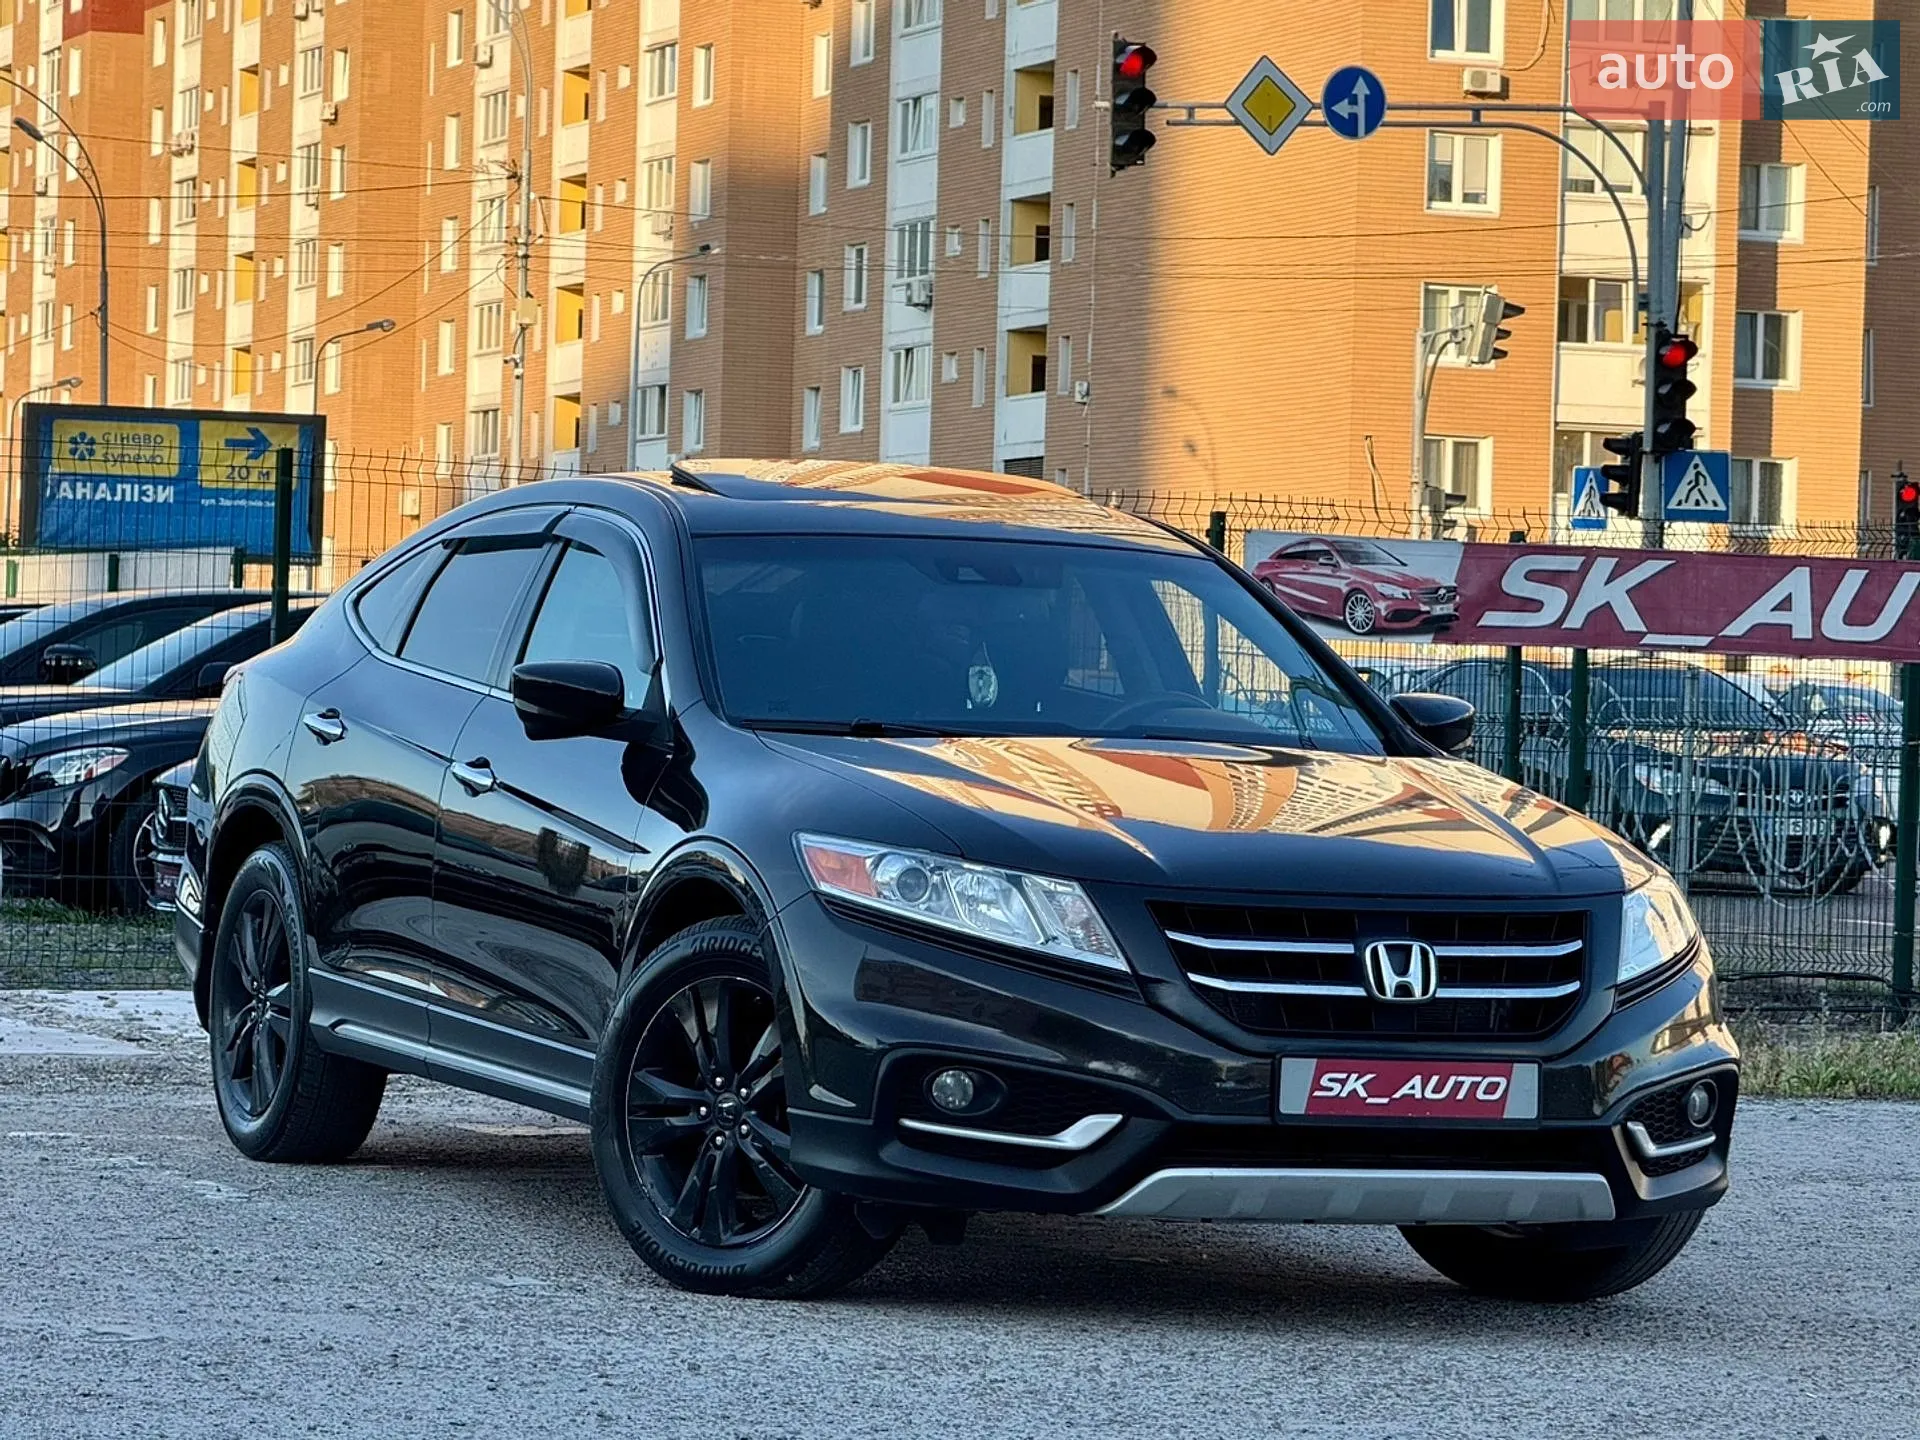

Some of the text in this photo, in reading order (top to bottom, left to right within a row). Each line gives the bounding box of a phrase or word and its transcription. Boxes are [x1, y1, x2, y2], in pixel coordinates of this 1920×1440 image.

[225, 466, 250, 480] 20
[57, 481, 174, 503] АНАЛІЗИ
[1312, 1072, 1508, 1104] SK_AUTO
